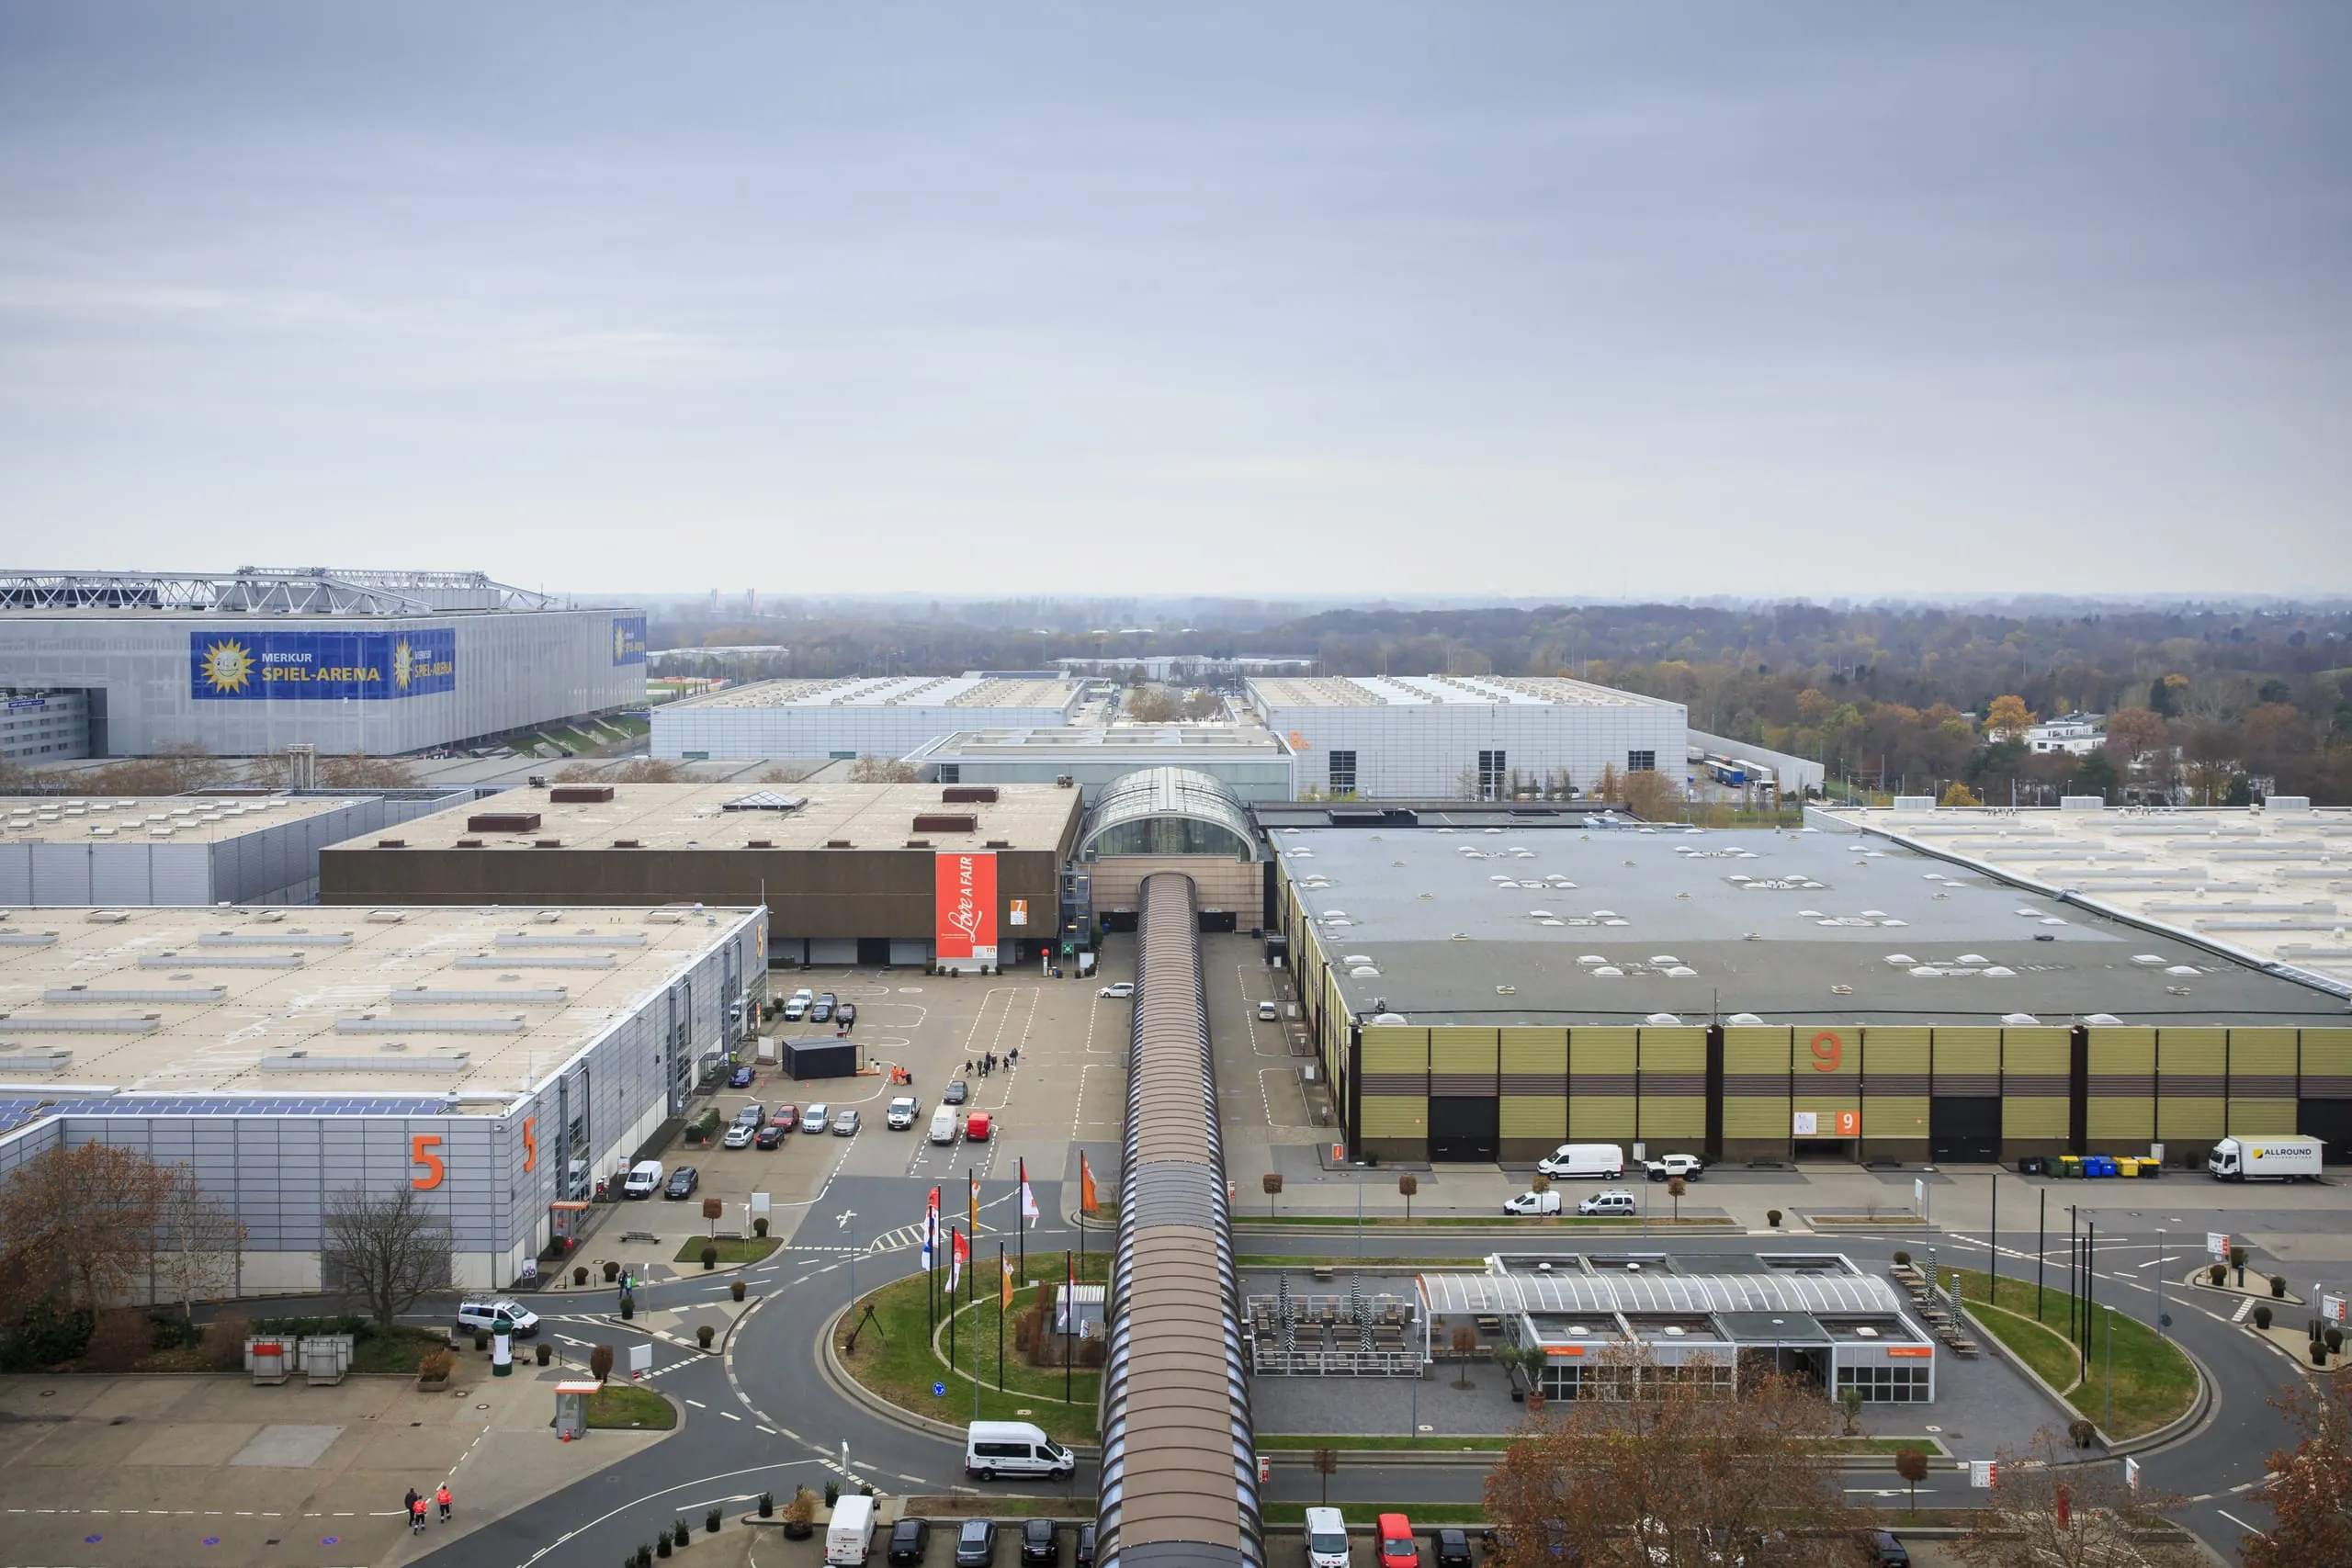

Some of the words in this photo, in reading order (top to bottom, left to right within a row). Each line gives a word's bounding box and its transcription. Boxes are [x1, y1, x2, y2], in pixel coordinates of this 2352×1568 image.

[261, 653, 312, 662] MERKUR
[261, 667, 381, 682] SPIEL-ARENA
[414, 661, 453, 678] SPIEL-ARENA
[960, 856, 972, 886] FAIR
[960, 888, 972, 897] A
[1015, 900, 1023, 912] 7
[948, 897, 982, 942] Love
[1812, 1031, 1841, 1072] 9
[1843, 1113, 1853, 1129] 9
[523, 1116, 536, 1173] 5
[413, 1135, 444, 1190] 5
